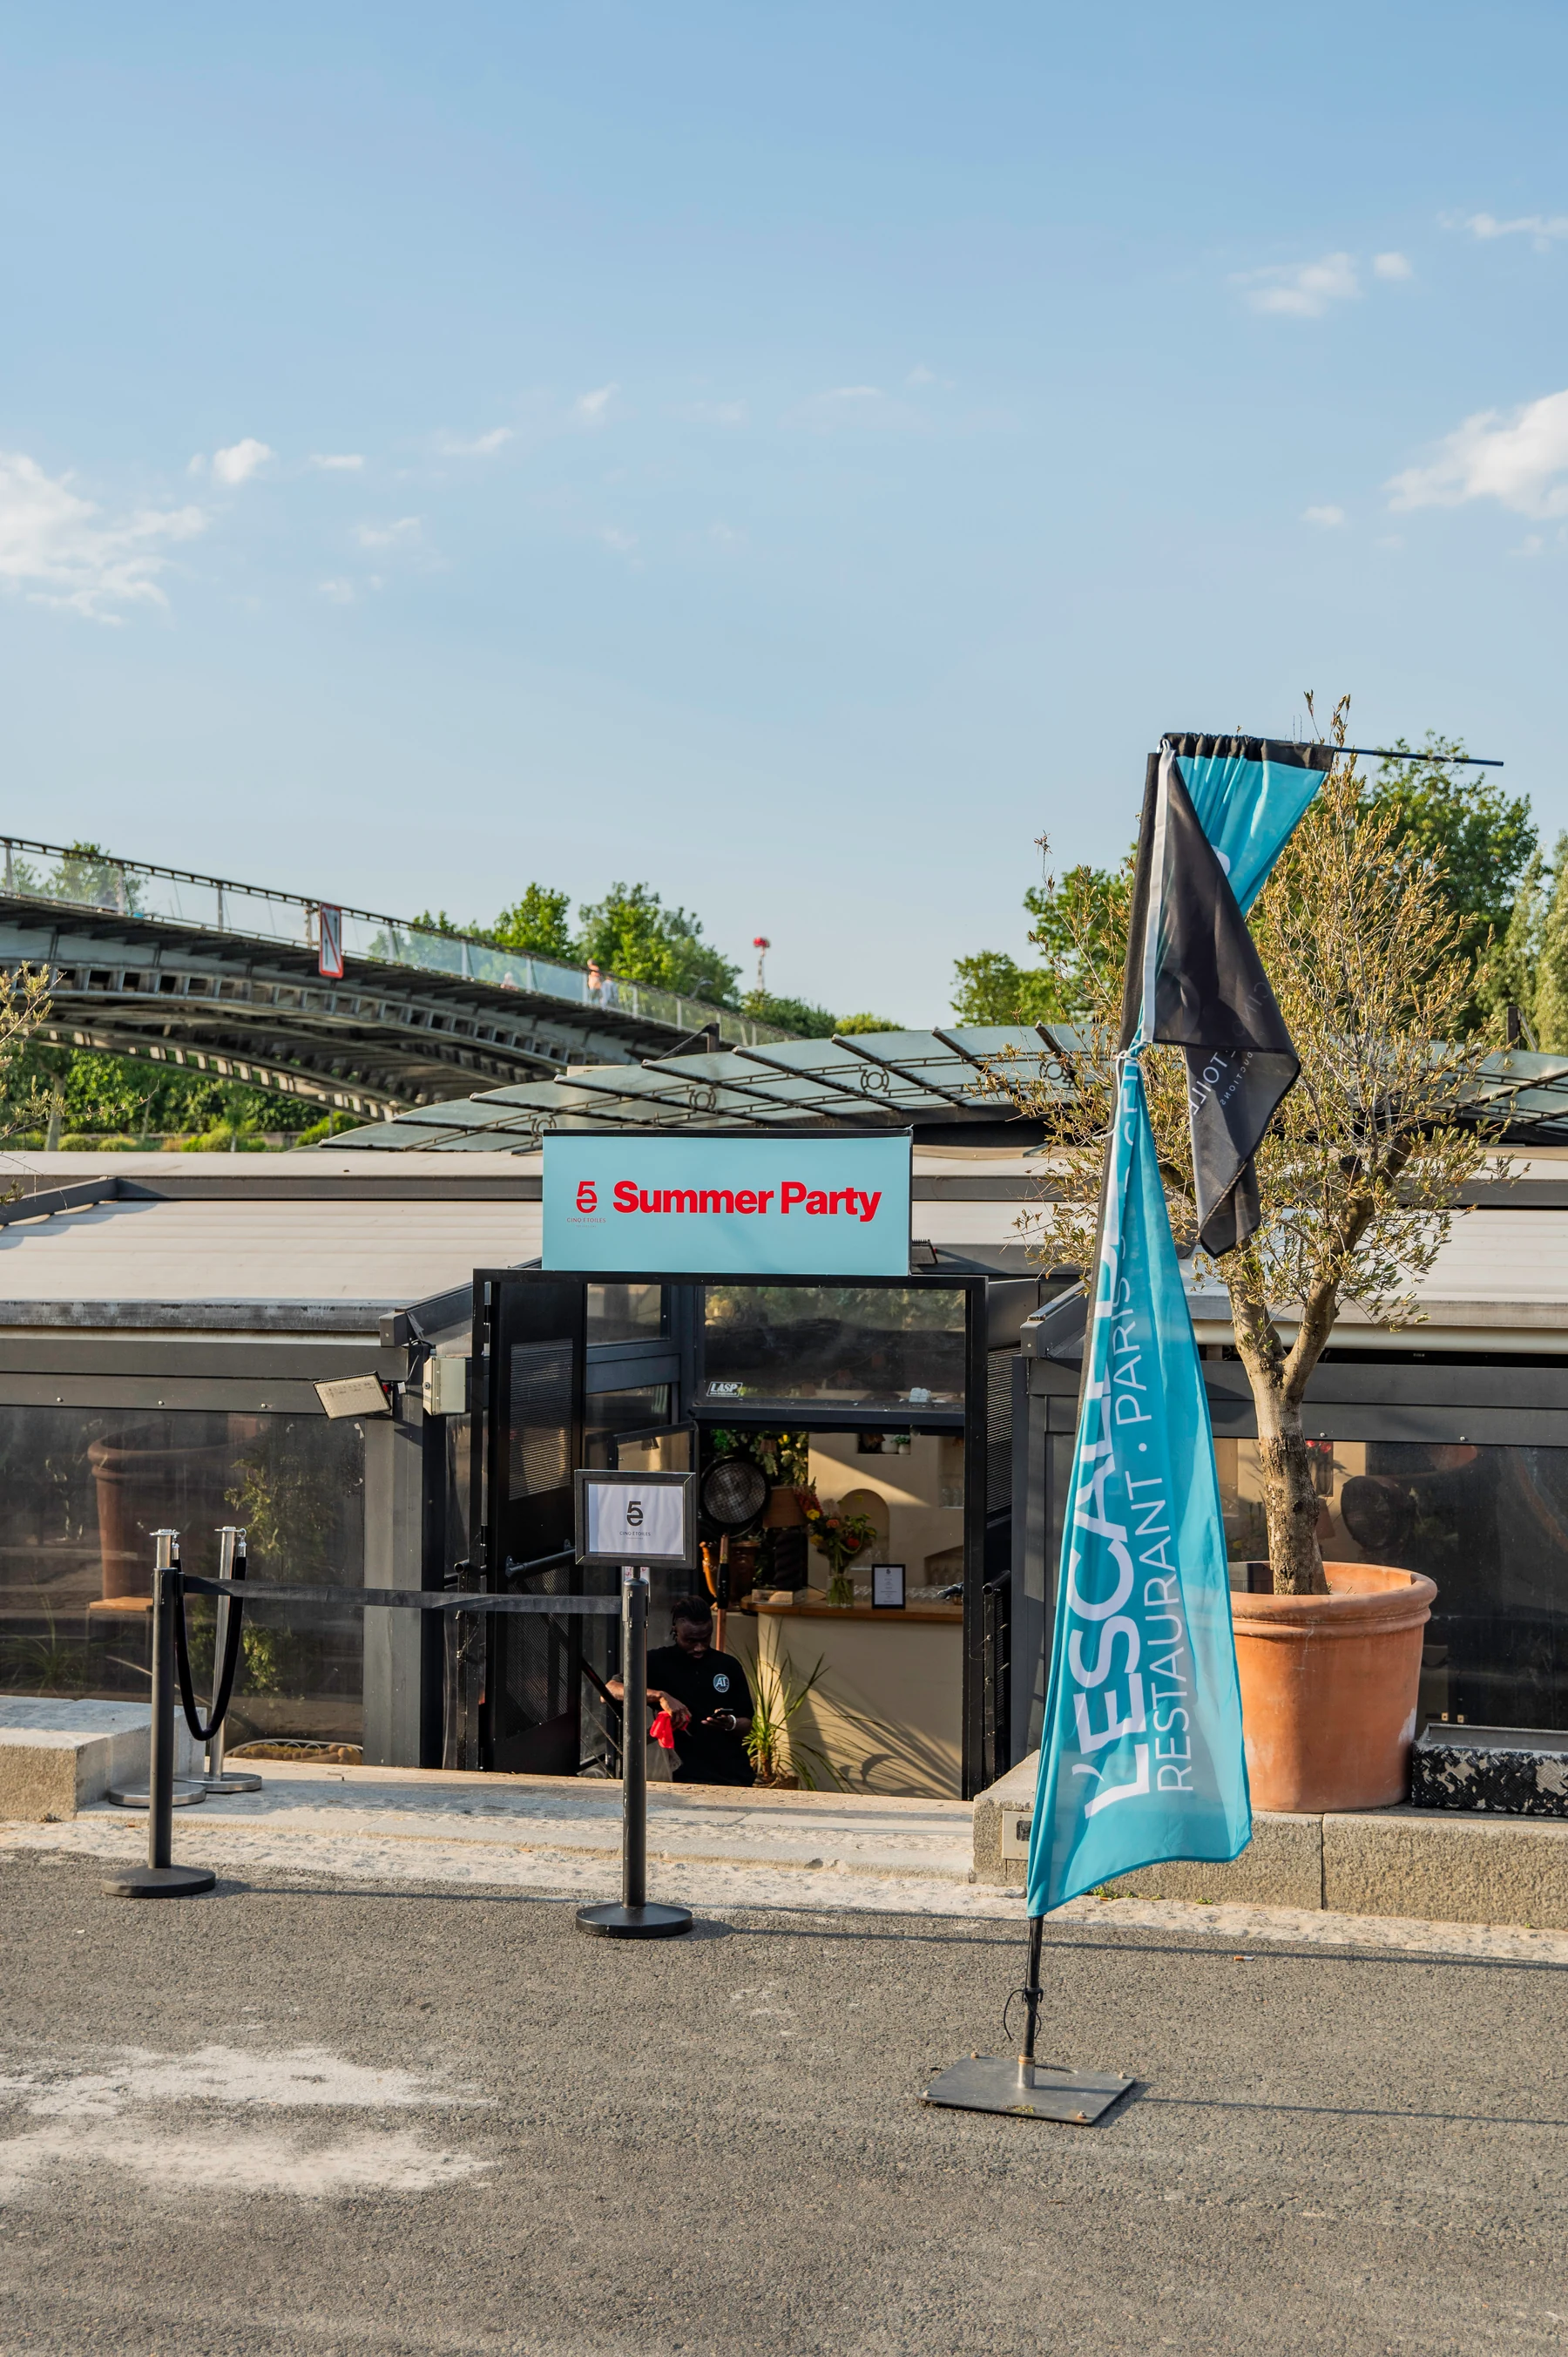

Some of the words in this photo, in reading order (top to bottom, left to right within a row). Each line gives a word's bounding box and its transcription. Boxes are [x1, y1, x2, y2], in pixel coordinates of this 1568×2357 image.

[612, 1180, 774, 1215] Summer
[781, 1181, 882, 1223] Party
[710, 1383, 739, 1392] LASP
[1111, 1277, 1152, 1426] PARIS
[1125, 1471, 1194, 1791] RESTAURANT
